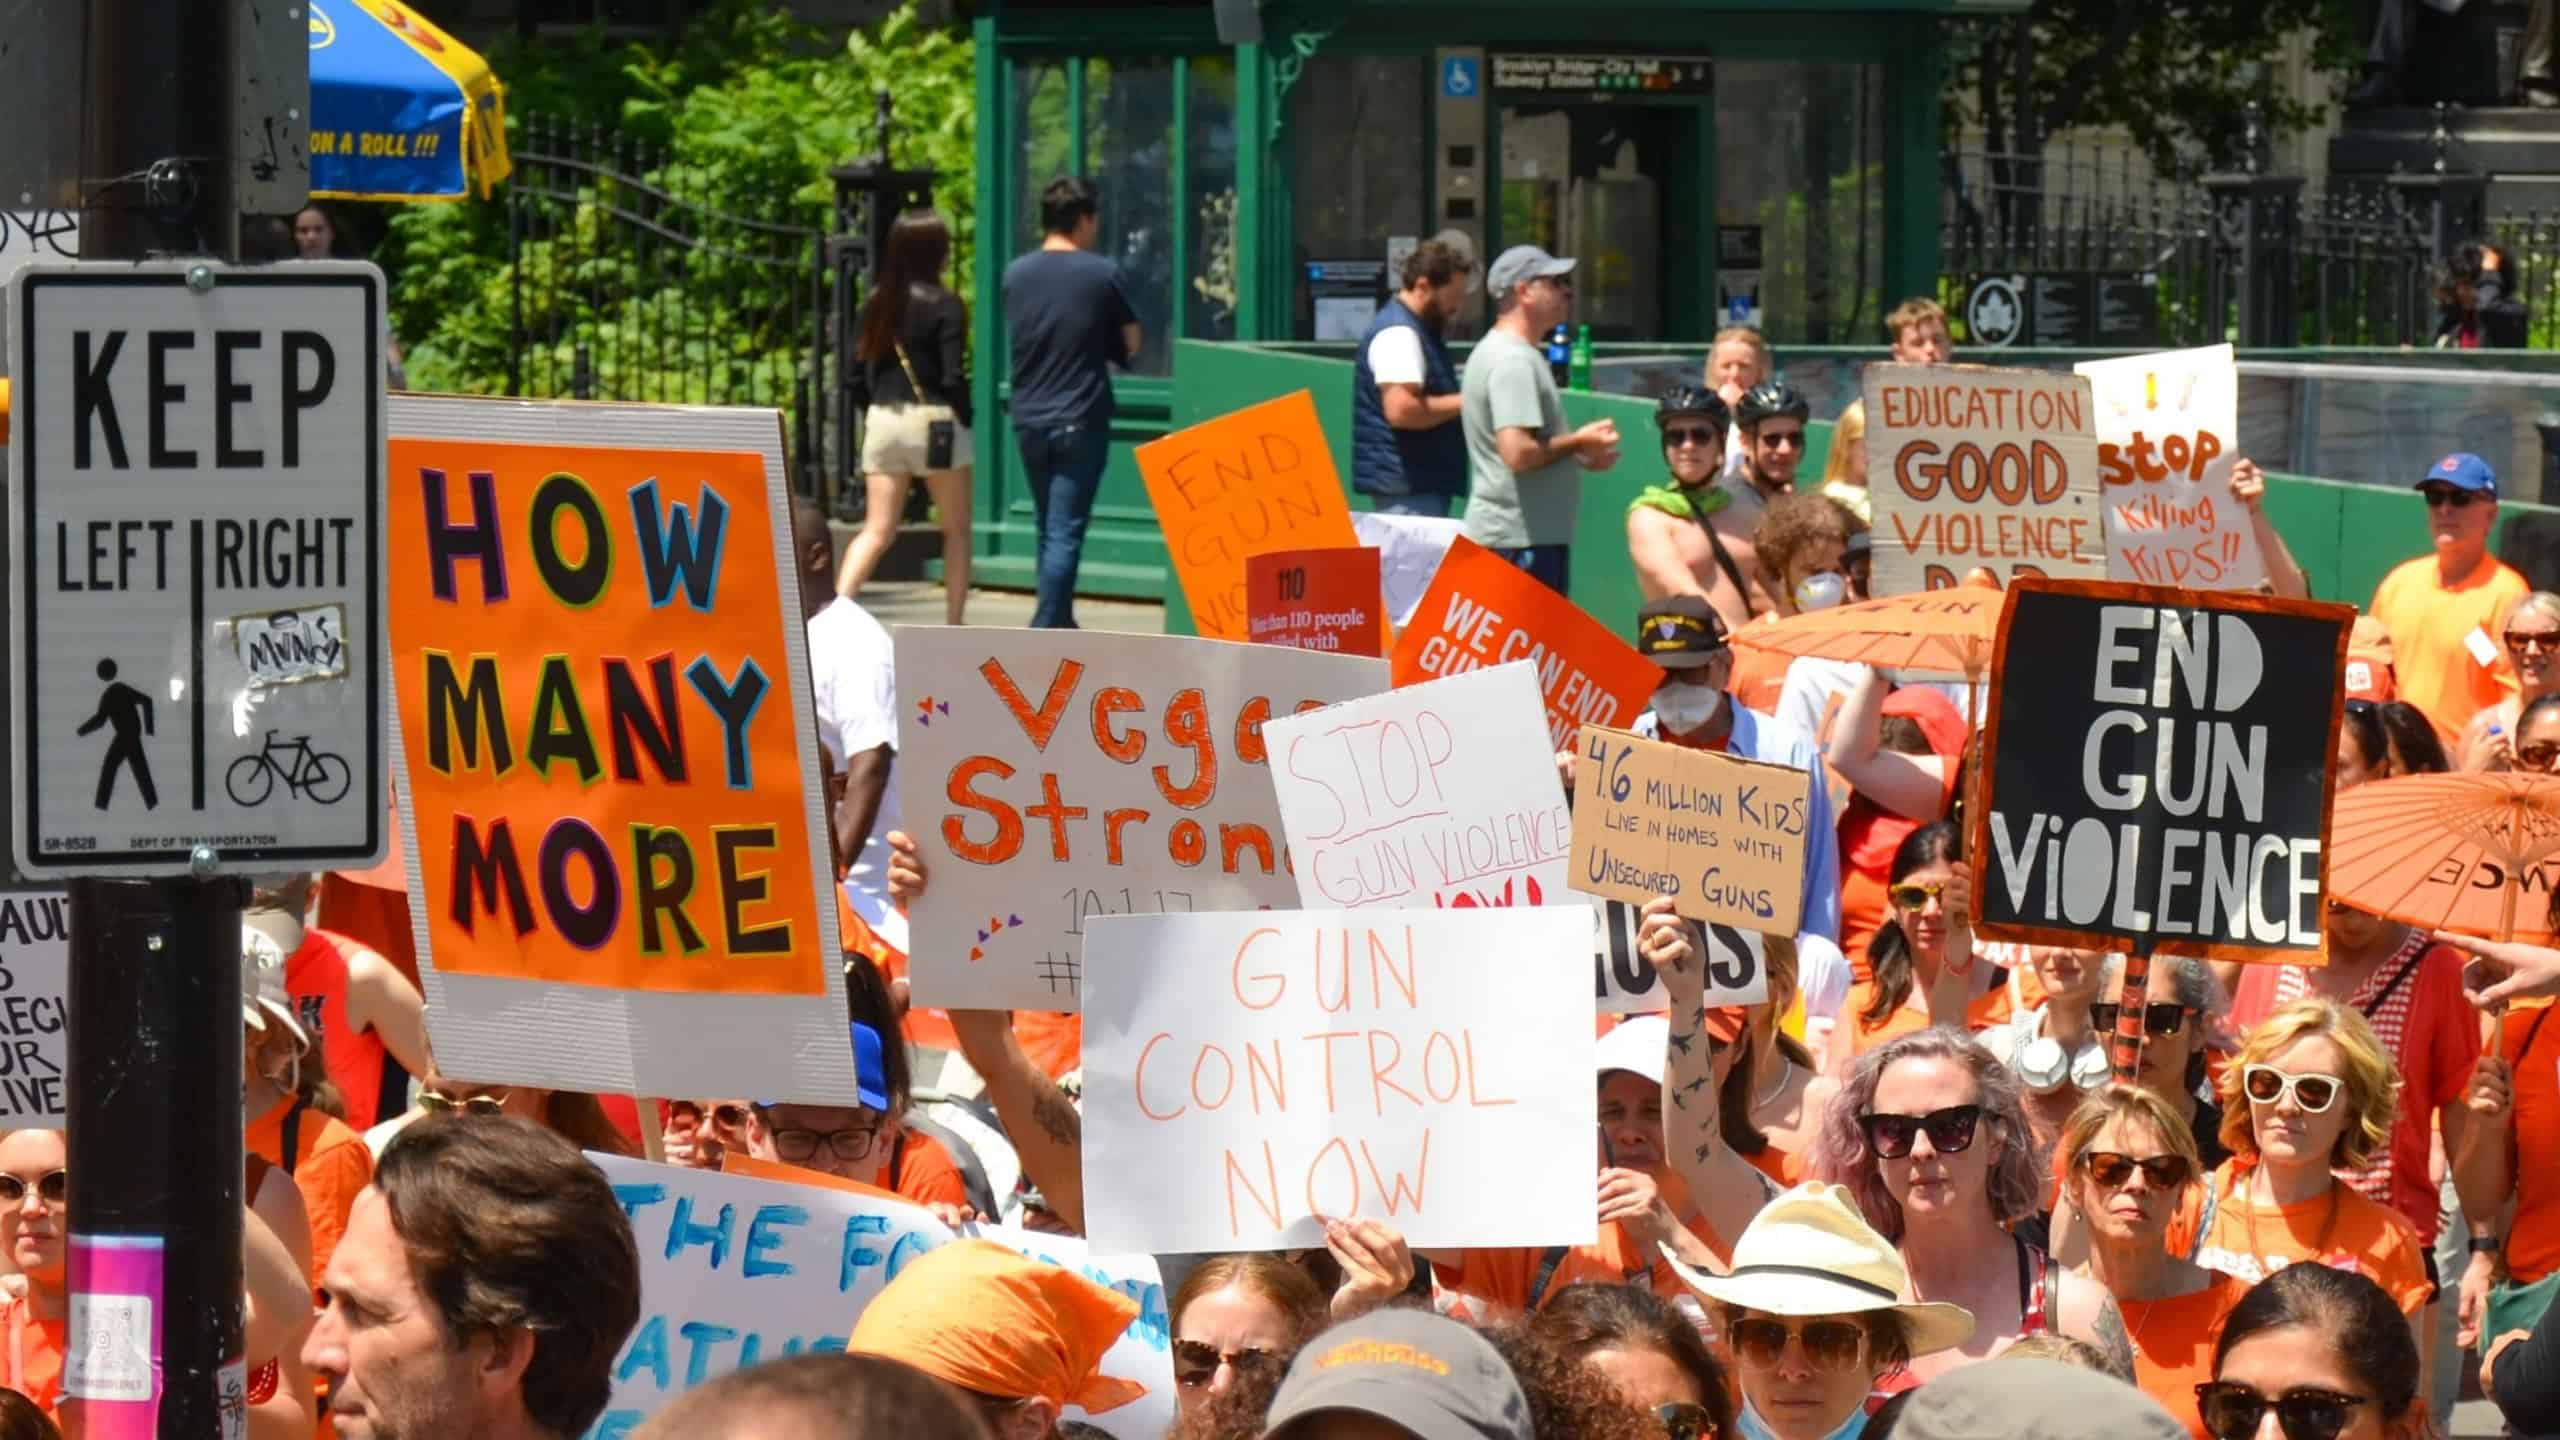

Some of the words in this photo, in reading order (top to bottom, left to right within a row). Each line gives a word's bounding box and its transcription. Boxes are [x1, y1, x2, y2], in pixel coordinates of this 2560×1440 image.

[339, 132, 353, 154] A
[360, 133, 407, 156] ROLL
[73, 330, 336, 470] KEEP
[1881, 385, 2083, 432] EDUCATION
[1168, 433, 1302, 511] END
[57, 520, 173, 592] LEFT
[215, 518, 354, 589] RIGHT
[419, 467, 729, 614] HOW
[1183, 479, 1322, 568] GUN
[1892, 512, 2091, 563] VIOLENCE
[1278, 568, 1305, 601] 110
[1315, 608, 1365, 632] people
[1304, 632, 1339, 649] with
[1443, 591, 1503, 654] WE
[1499, 628, 1567, 697] CAN
[1557, 669, 1618, 727] END
[2094, 605, 2264, 712] END
[422, 648, 770, 790] MANY
[1288, 710, 1452, 840] STOP
[1590, 735, 1633, 803] 4.6
[1646, 778, 1722, 817] MILLION
[2082, 709, 2268, 823] GUN
[130, 838, 158, 849] DEPT
[161, 837, 176, 848] OF
[180, 834, 277, 847] TRANSPORTATION
[941, 755, 1296, 876] Stron
[1313, 839, 1417, 905] GUN
[1422, 805, 1571, 886] VIOLENCE
[1606, 810, 1640, 833] LIVE
[1648, 819, 1661, 836] IN
[1666, 826, 1719, 848] HOMES
[1734, 837, 1783, 863] WITH
[450, 811, 792, 959] MORE
[1589, 845, 1680, 896] UNSECURED
[1701, 867, 1775, 918] GUNS
[1232, 925, 1418, 1014] GUN
[1135, 1029, 1517, 1122] CONTROL
[1225, 1128, 1431, 1238] NOW
[612, 1182, 811, 1279] THE
